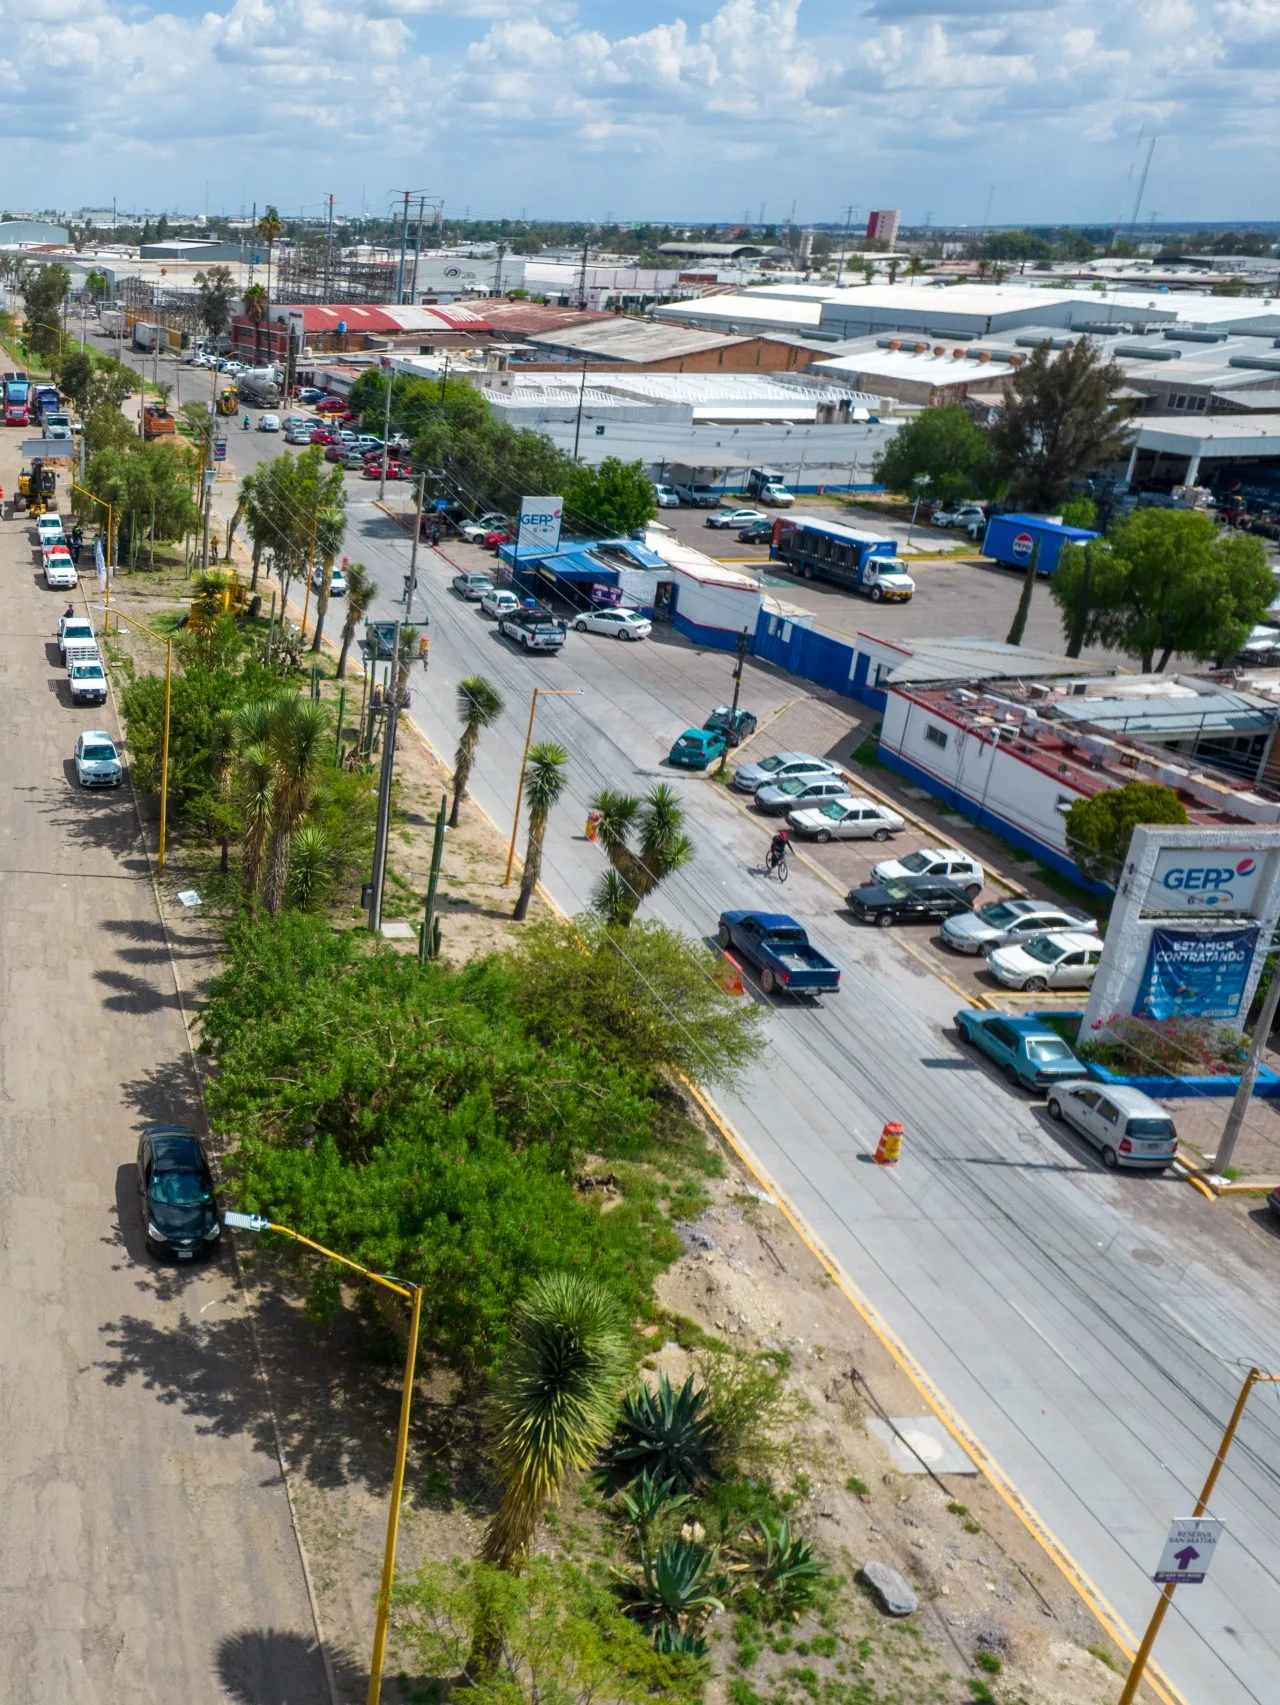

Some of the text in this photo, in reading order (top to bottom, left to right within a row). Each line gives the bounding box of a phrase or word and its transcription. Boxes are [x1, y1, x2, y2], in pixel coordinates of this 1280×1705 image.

[521, 513, 554, 526] GEPP
[1163, 867, 1235, 890] GEPP
[1172, 940, 1234, 951] ESTAMOS
[1156, 950, 1245, 962] CONTRATANDO
